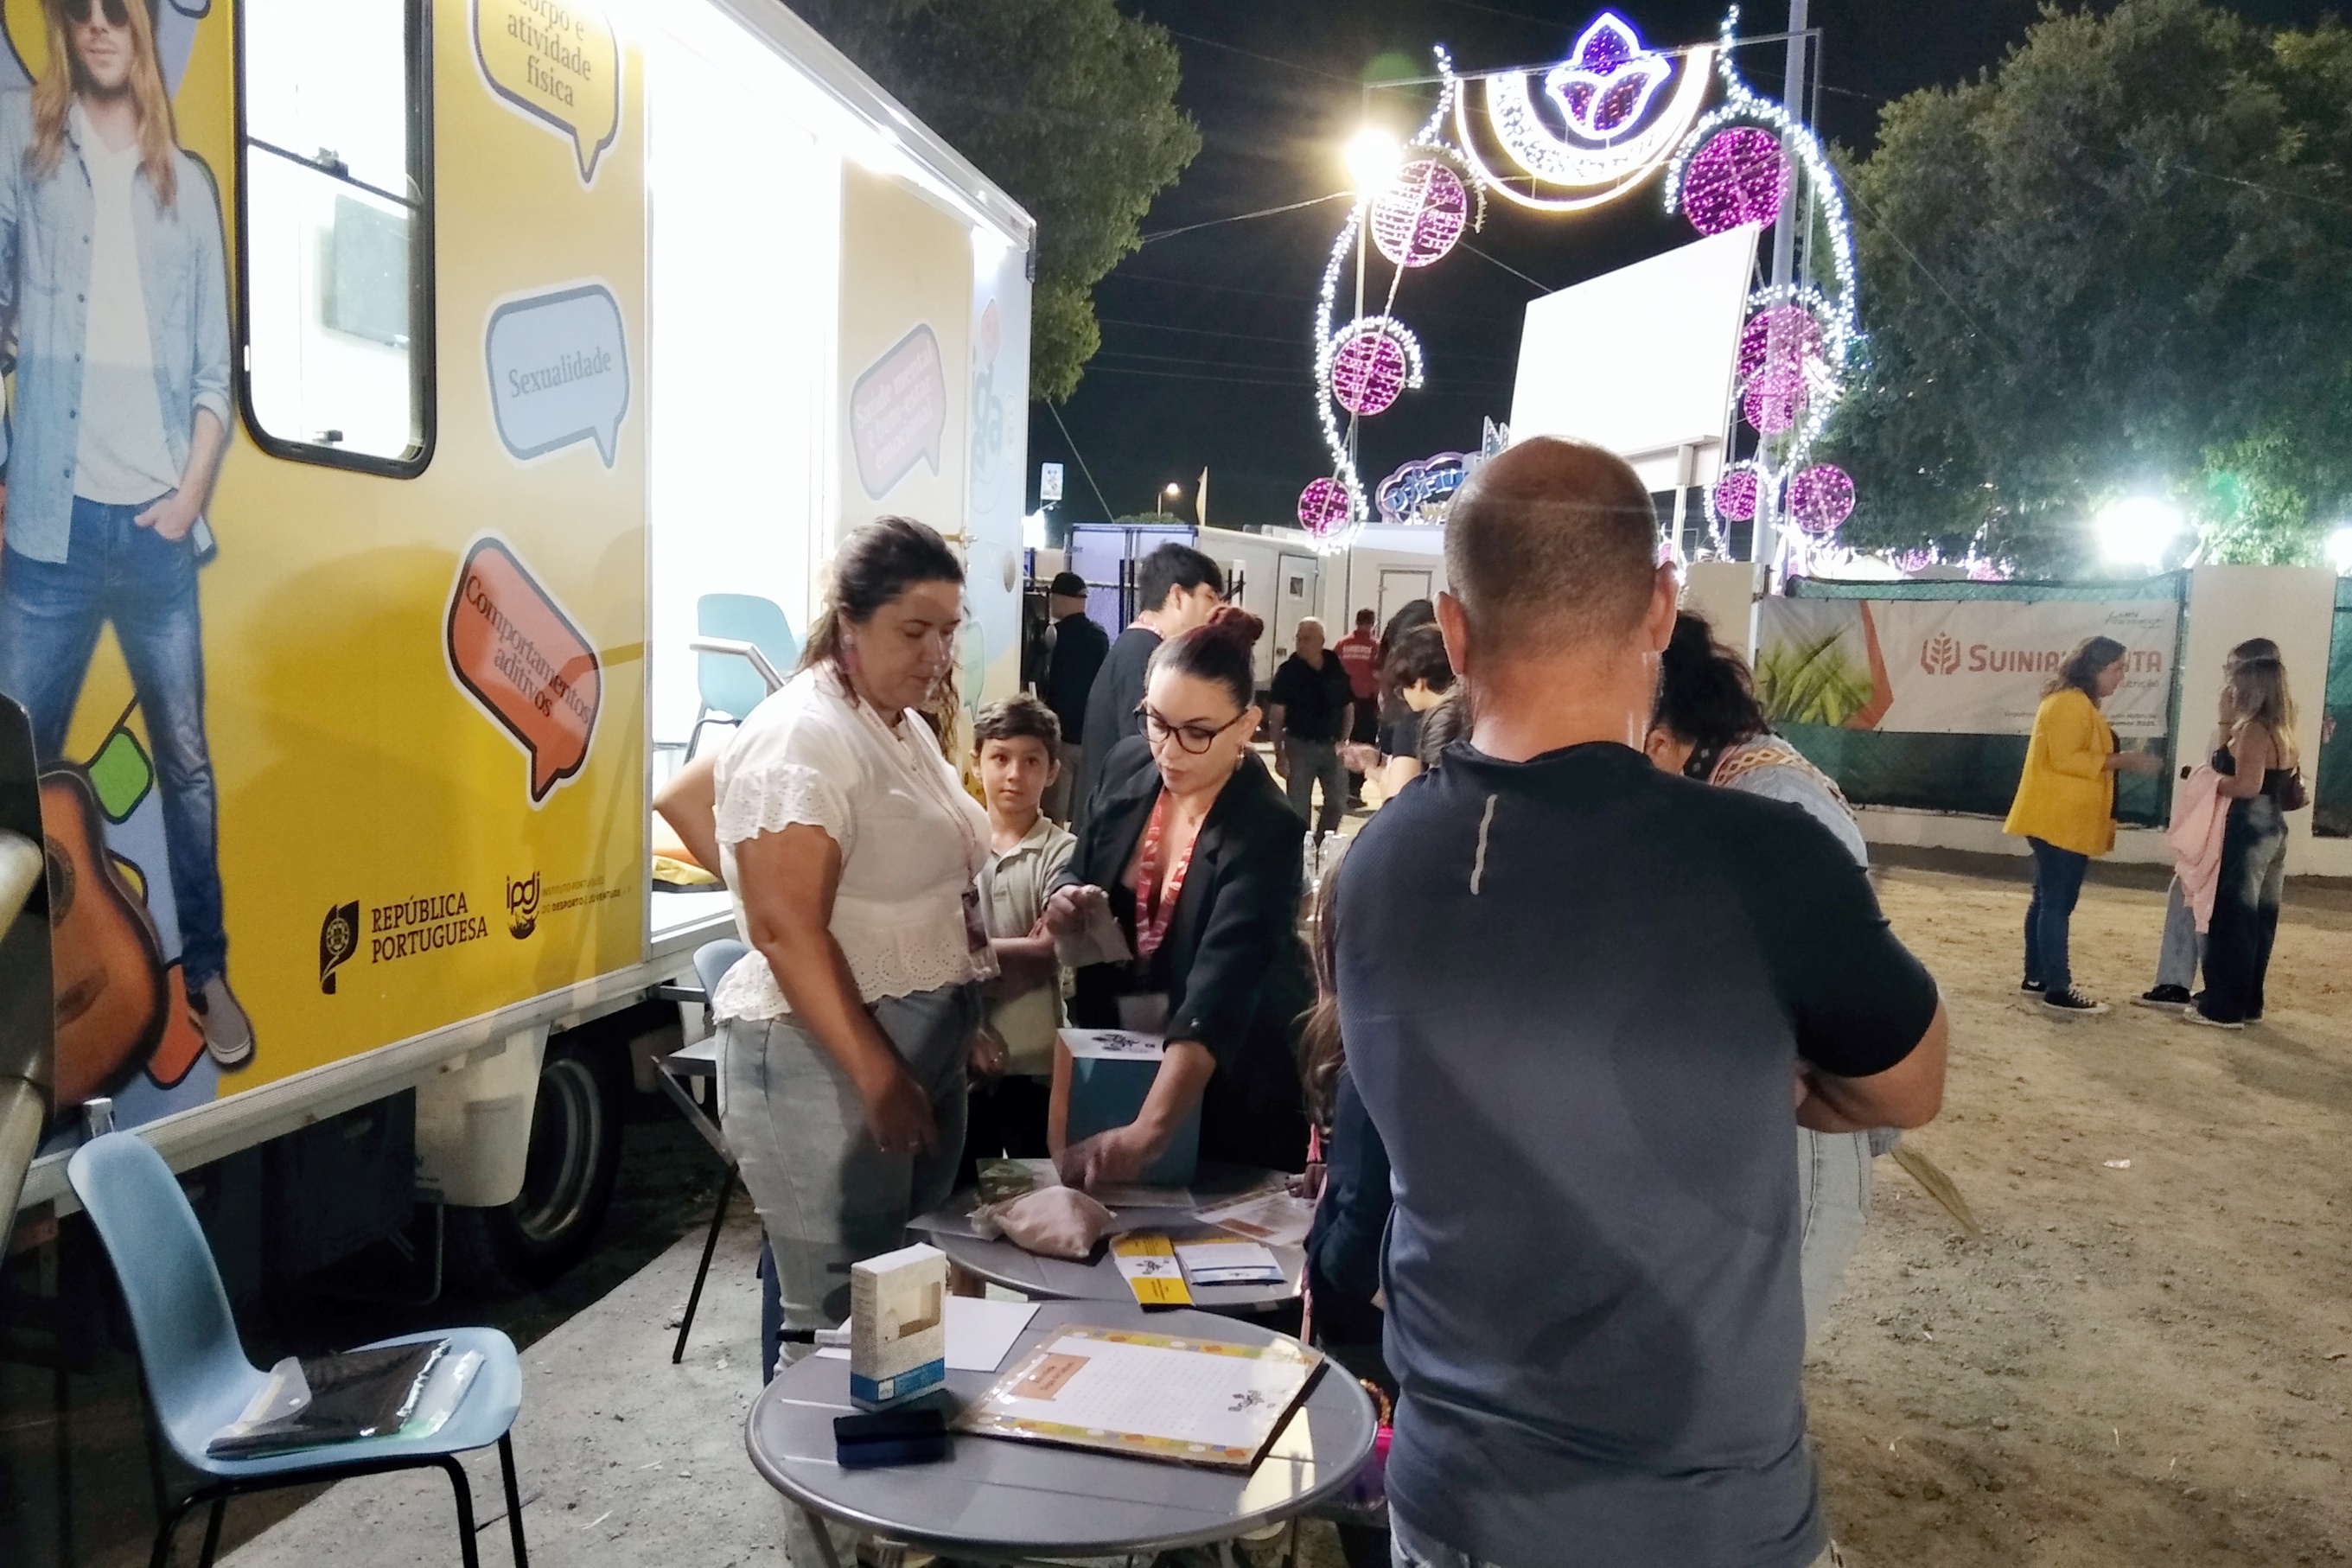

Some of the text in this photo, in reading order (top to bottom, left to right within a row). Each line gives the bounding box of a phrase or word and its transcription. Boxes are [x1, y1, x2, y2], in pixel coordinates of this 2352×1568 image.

[507, 14, 591, 81] atividade
[575, 21, 584, 41] e
[527, 54, 575, 107] física
[508, 346, 612, 398] Sexualidade
[855, 338, 934, 430] Saúde mental
[867, 375, 932, 449] e bem-estar
[876, 395, 934, 471] emocional
[465, 575, 590, 724] Comportamentos
[494, 647, 553, 717] aditivos
[372, 891, 468, 933] REPÚBLICA
[542, 882, 571, 896] INSTITUTO
[551, 896, 583, 912] DESPORTO
[589, 888, 621, 904] JUVENTUDE
[372, 915, 488, 964] PORTUGUESA
